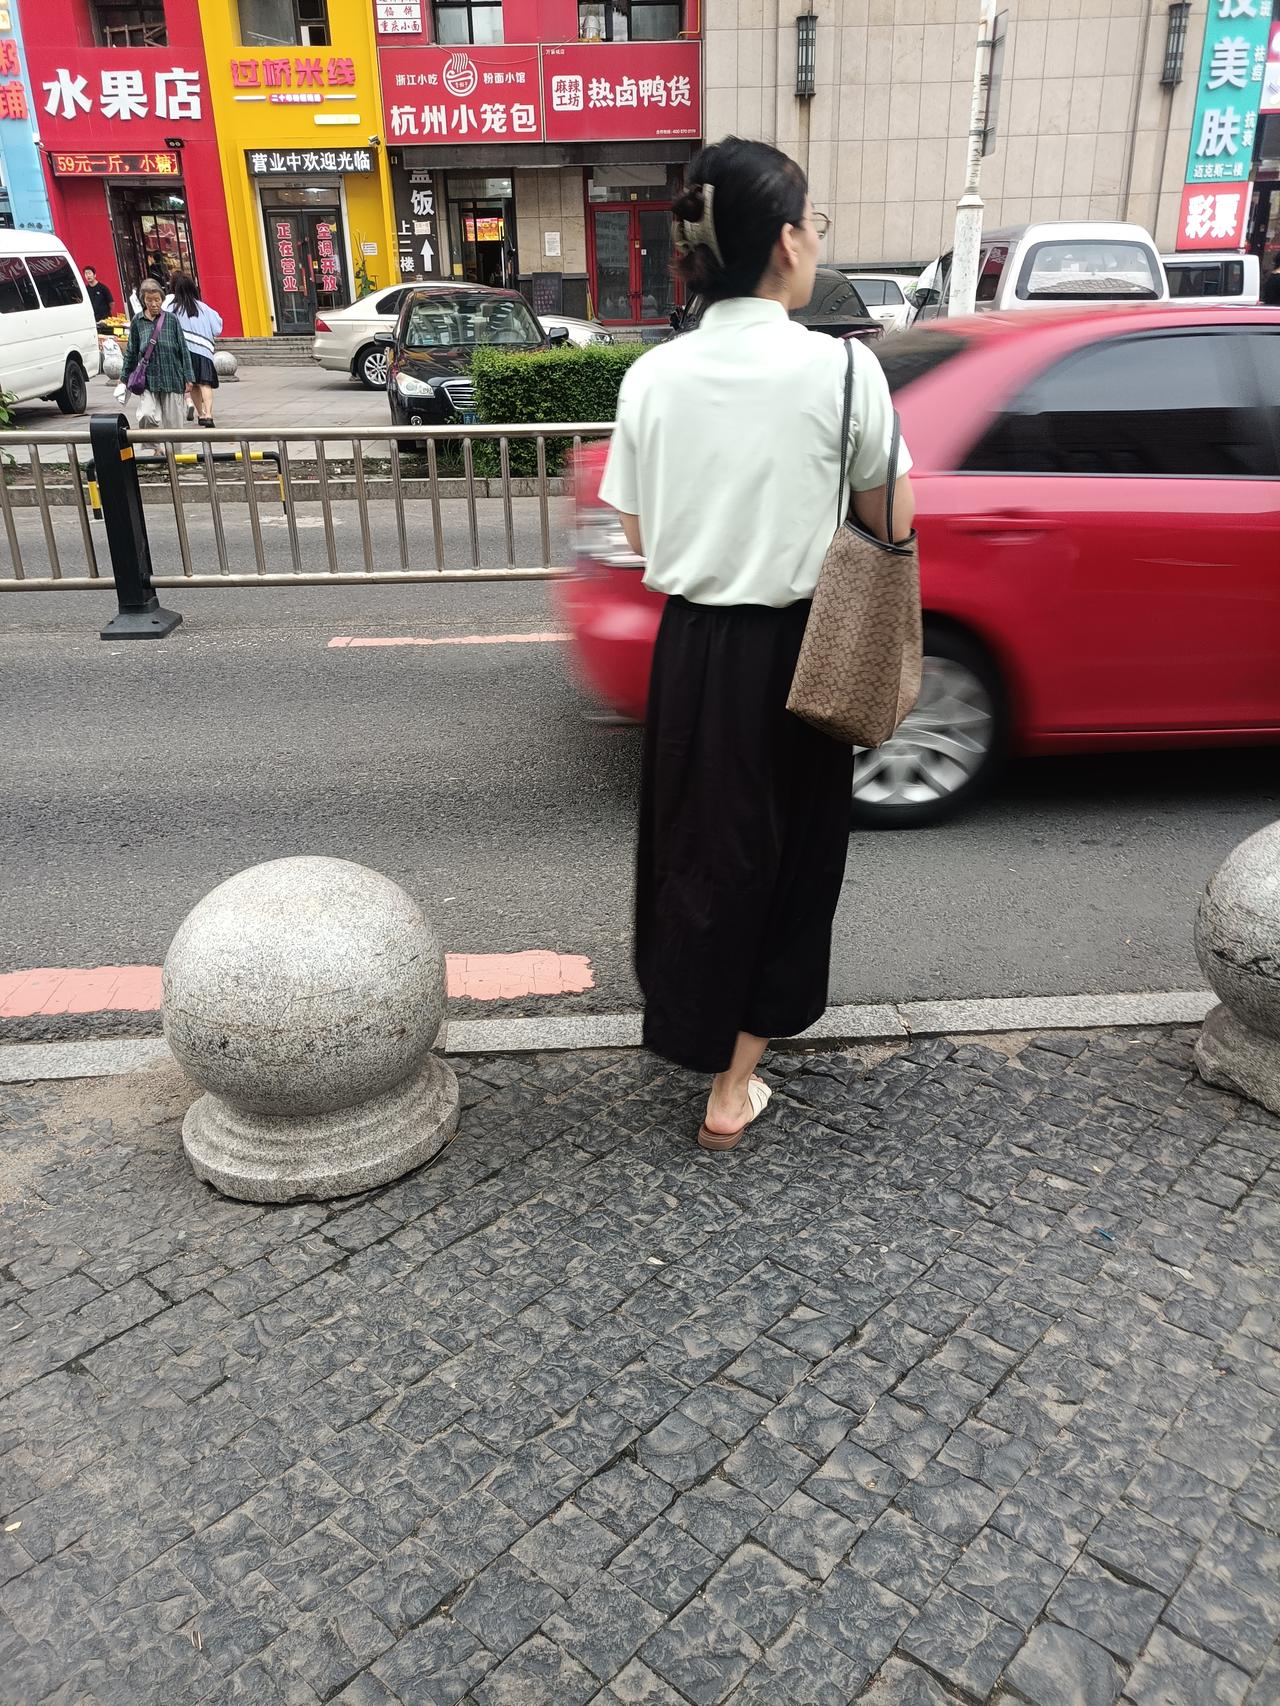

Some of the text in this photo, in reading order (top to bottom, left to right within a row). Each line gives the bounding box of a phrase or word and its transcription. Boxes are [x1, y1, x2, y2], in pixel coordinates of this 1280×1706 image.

[382, 20, 420, 32] 重庆小面
[230, 57, 356, 87] 过桥米线
[395, 74, 438, 86] 浙江小吃
[483, 72, 526, 85] 粉面小馆
[555, 79, 581, 93] 麻辣
[42, 67, 201, 120] 水果店
[556, 94, 580, 107] 工坊
[587, 75, 692, 108] 热卤鸭货
[391, 103, 537, 136] 杭州小笼包
[251, 151, 371, 173] 营业中欢迎光临
[1185, 193, 1240, 239] 彩票
[276, 223, 298, 292] 正在营业
[315, 223, 338, 292] 空调开放
[398, 220, 415, 272] 上二楼
